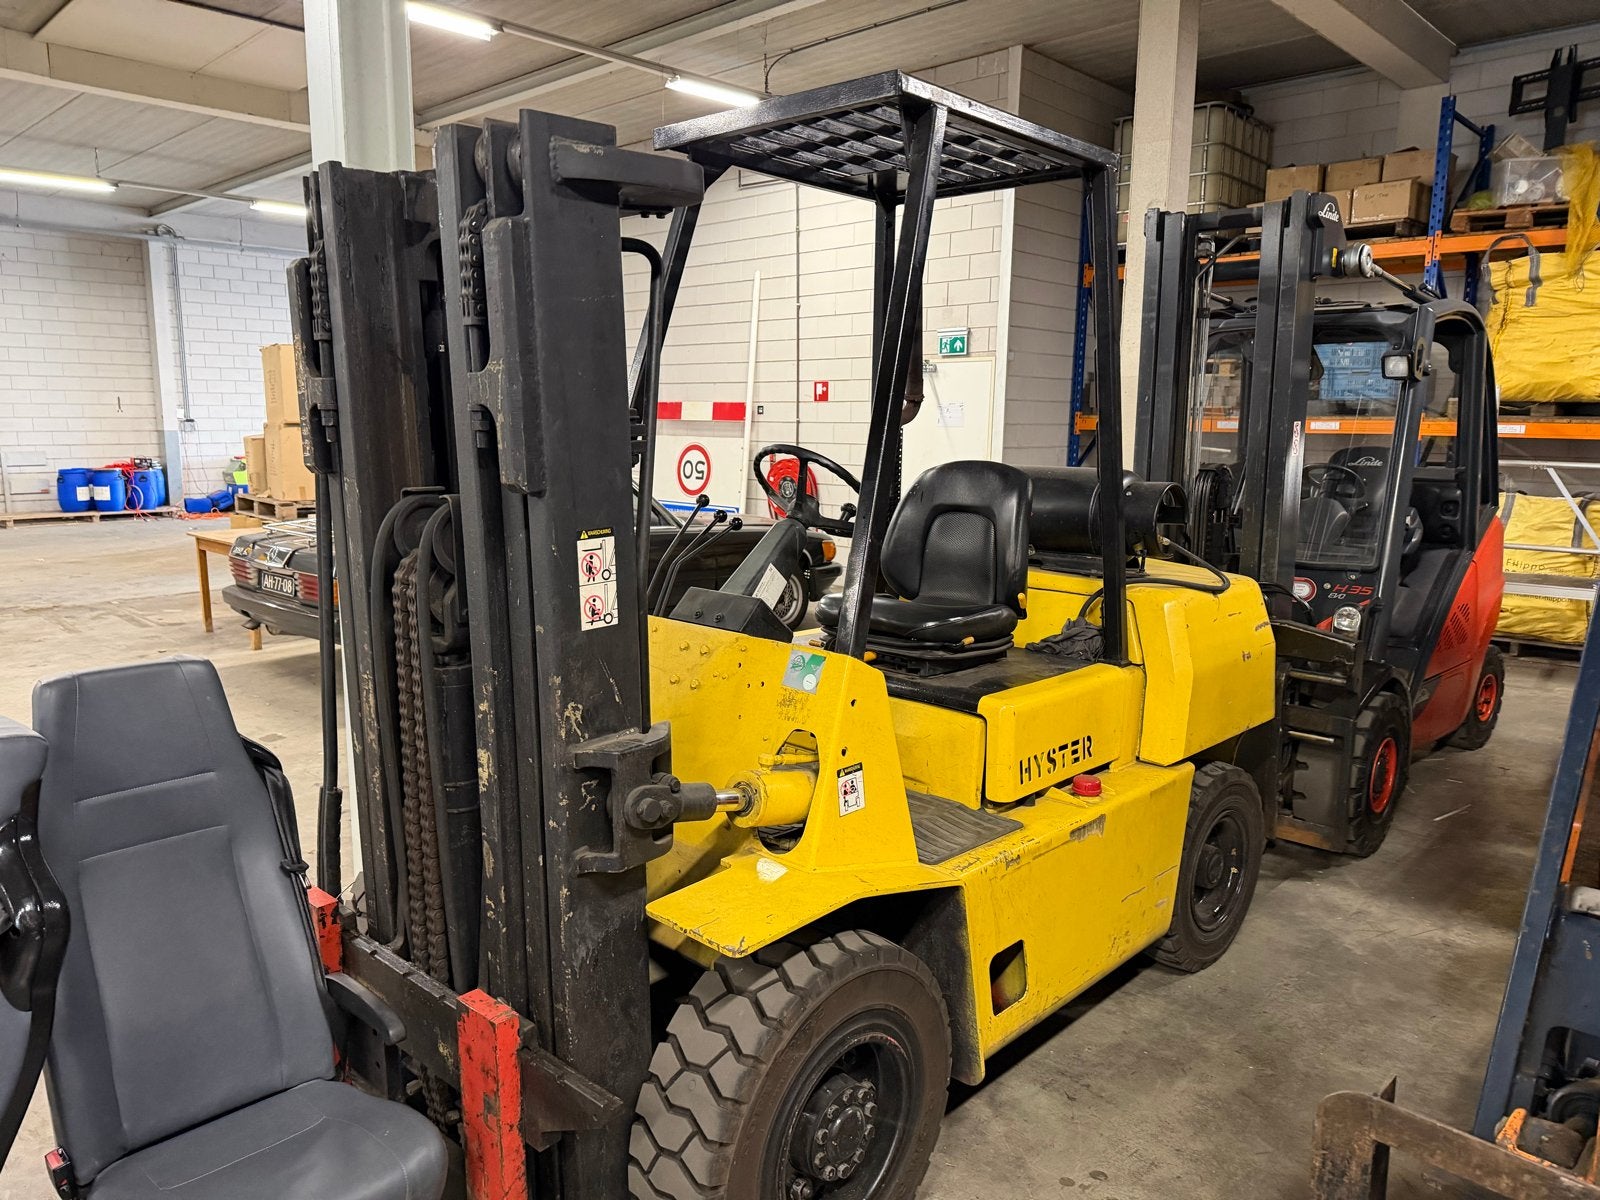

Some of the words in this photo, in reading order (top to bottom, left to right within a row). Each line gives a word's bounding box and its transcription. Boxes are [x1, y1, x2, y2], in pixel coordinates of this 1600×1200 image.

[1318, 202, 1340, 223] Linde
[682, 459, 706, 481] 50
[1347, 455, 1384, 467] Linde
[263, 574, 292, 594] AH-77-08
[1019, 735, 1093, 785] HYSTER
